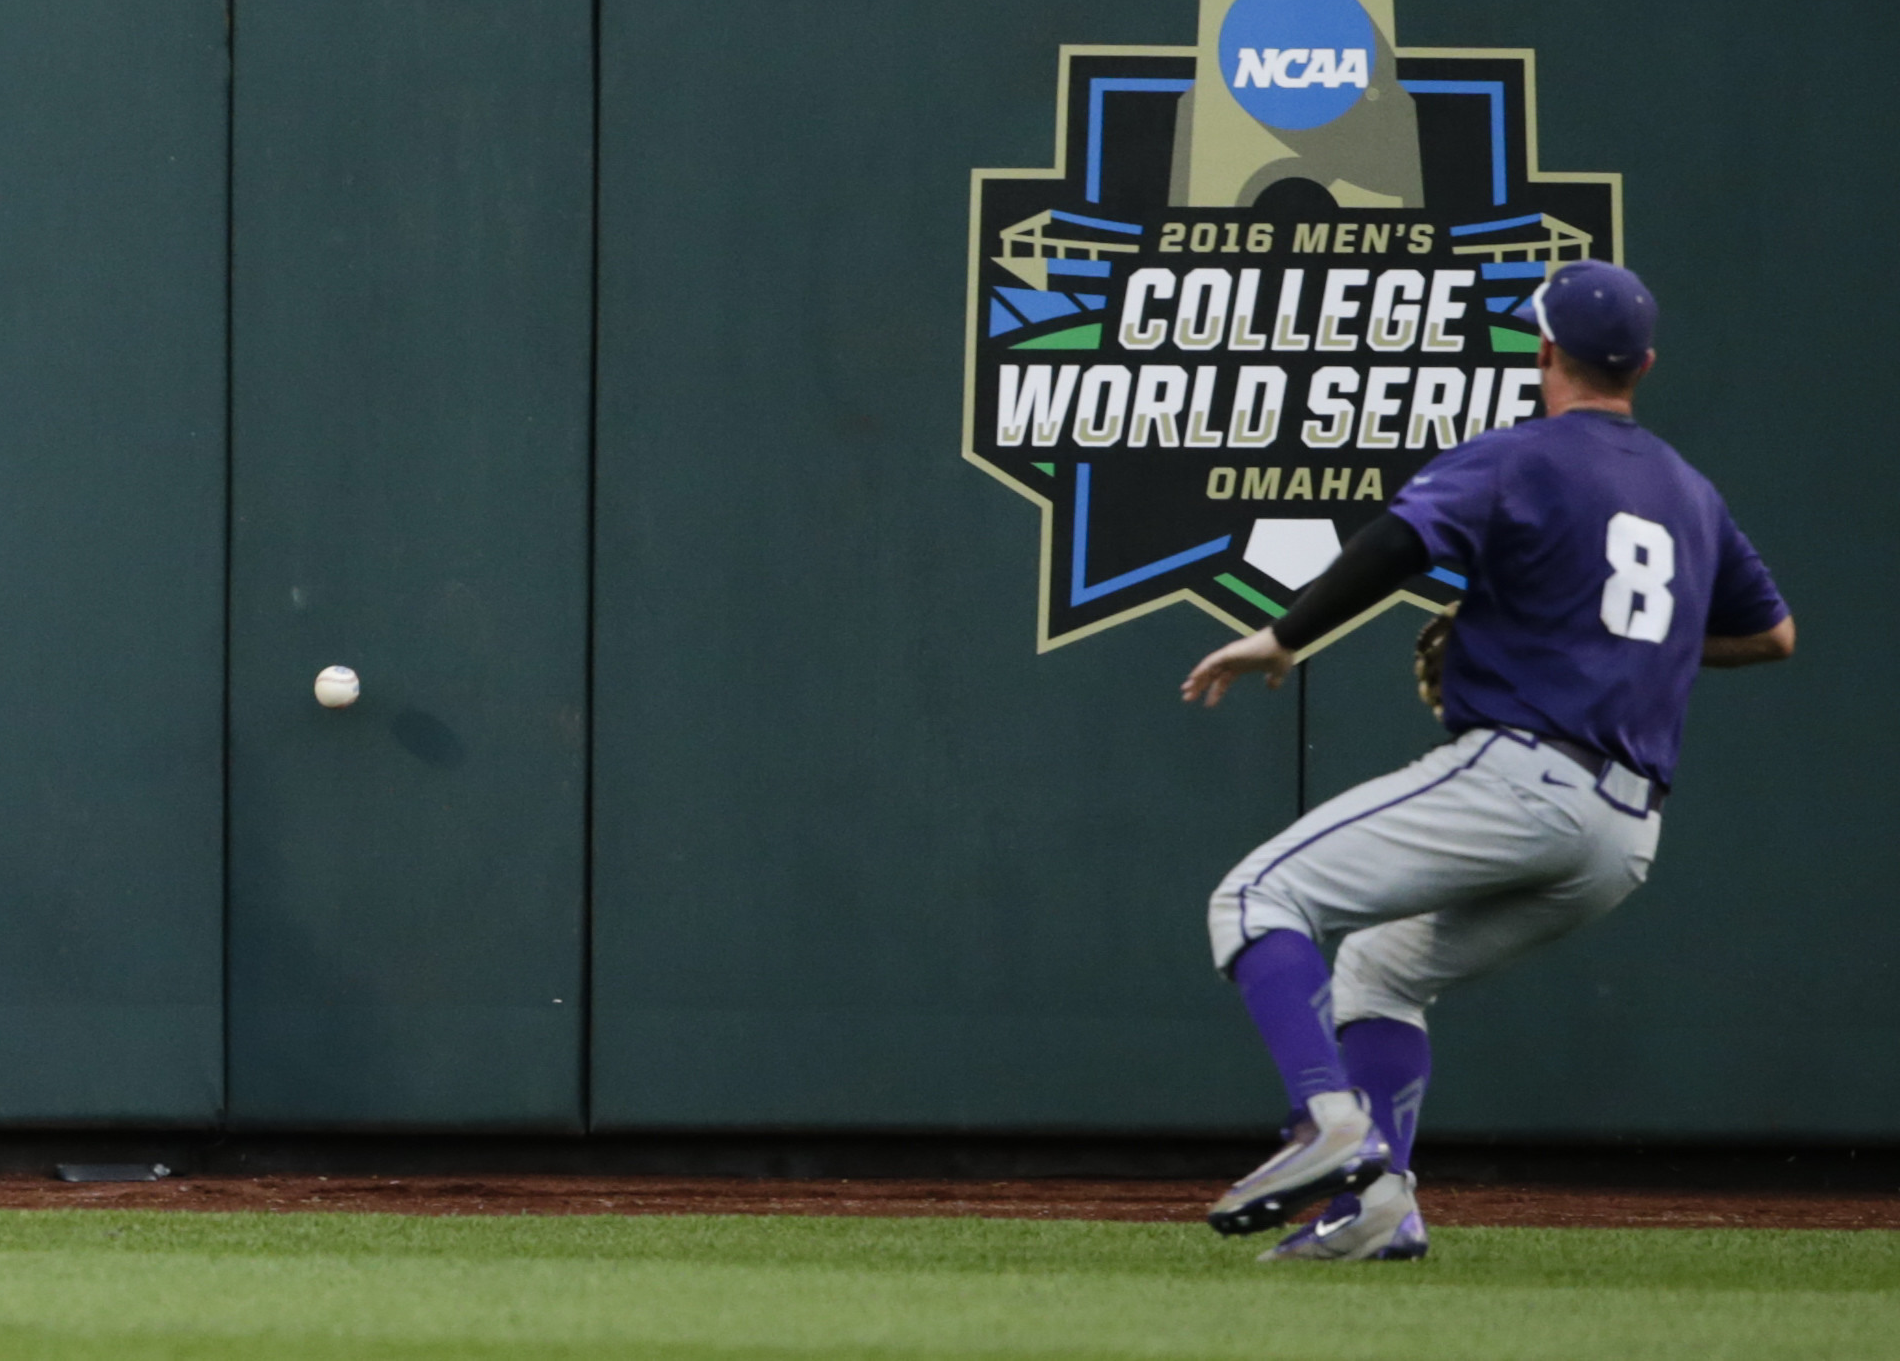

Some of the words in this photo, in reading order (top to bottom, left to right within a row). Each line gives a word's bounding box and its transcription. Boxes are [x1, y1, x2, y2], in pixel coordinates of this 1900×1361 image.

[1233, 47, 1370, 89] NCAA
[1158, 222, 1274, 253] 2016
[1292, 222, 1435, 254] MEN'S
[1118, 267, 1476, 353] COLLEGE
[997, 364, 1288, 448] WORLD
[1300, 366, 1542, 449] SERIE
[1206, 467, 1384, 501] OMAHA
[1600, 510, 1675, 644] 8
